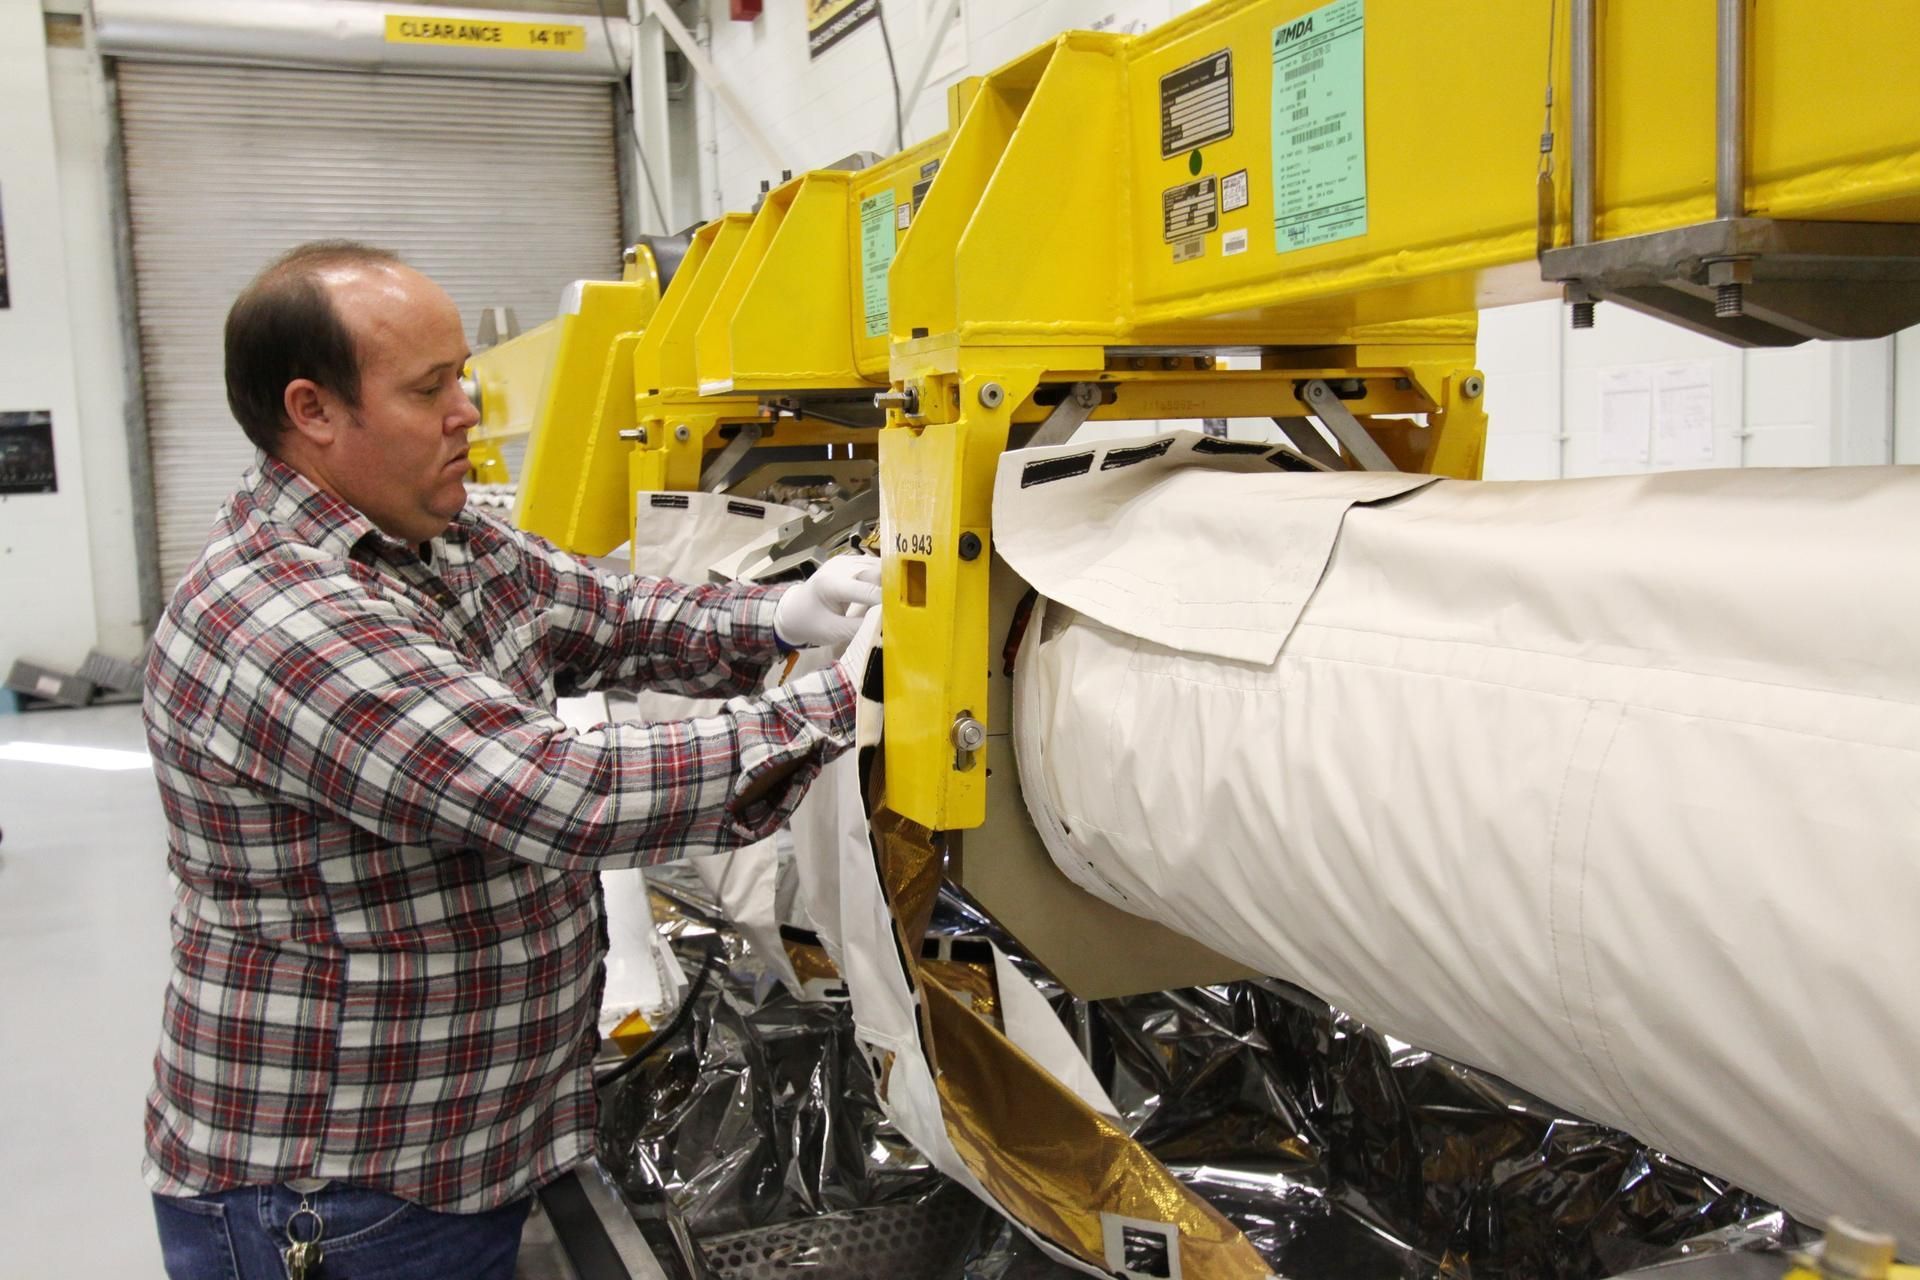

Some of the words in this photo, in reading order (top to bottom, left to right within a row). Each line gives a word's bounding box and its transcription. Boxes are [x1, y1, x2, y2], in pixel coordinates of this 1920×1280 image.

[400, 21, 502, 42] CLEARANCE
[1284, 16, 1313, 44] MDA
[911, 534, 932, 556] 943
